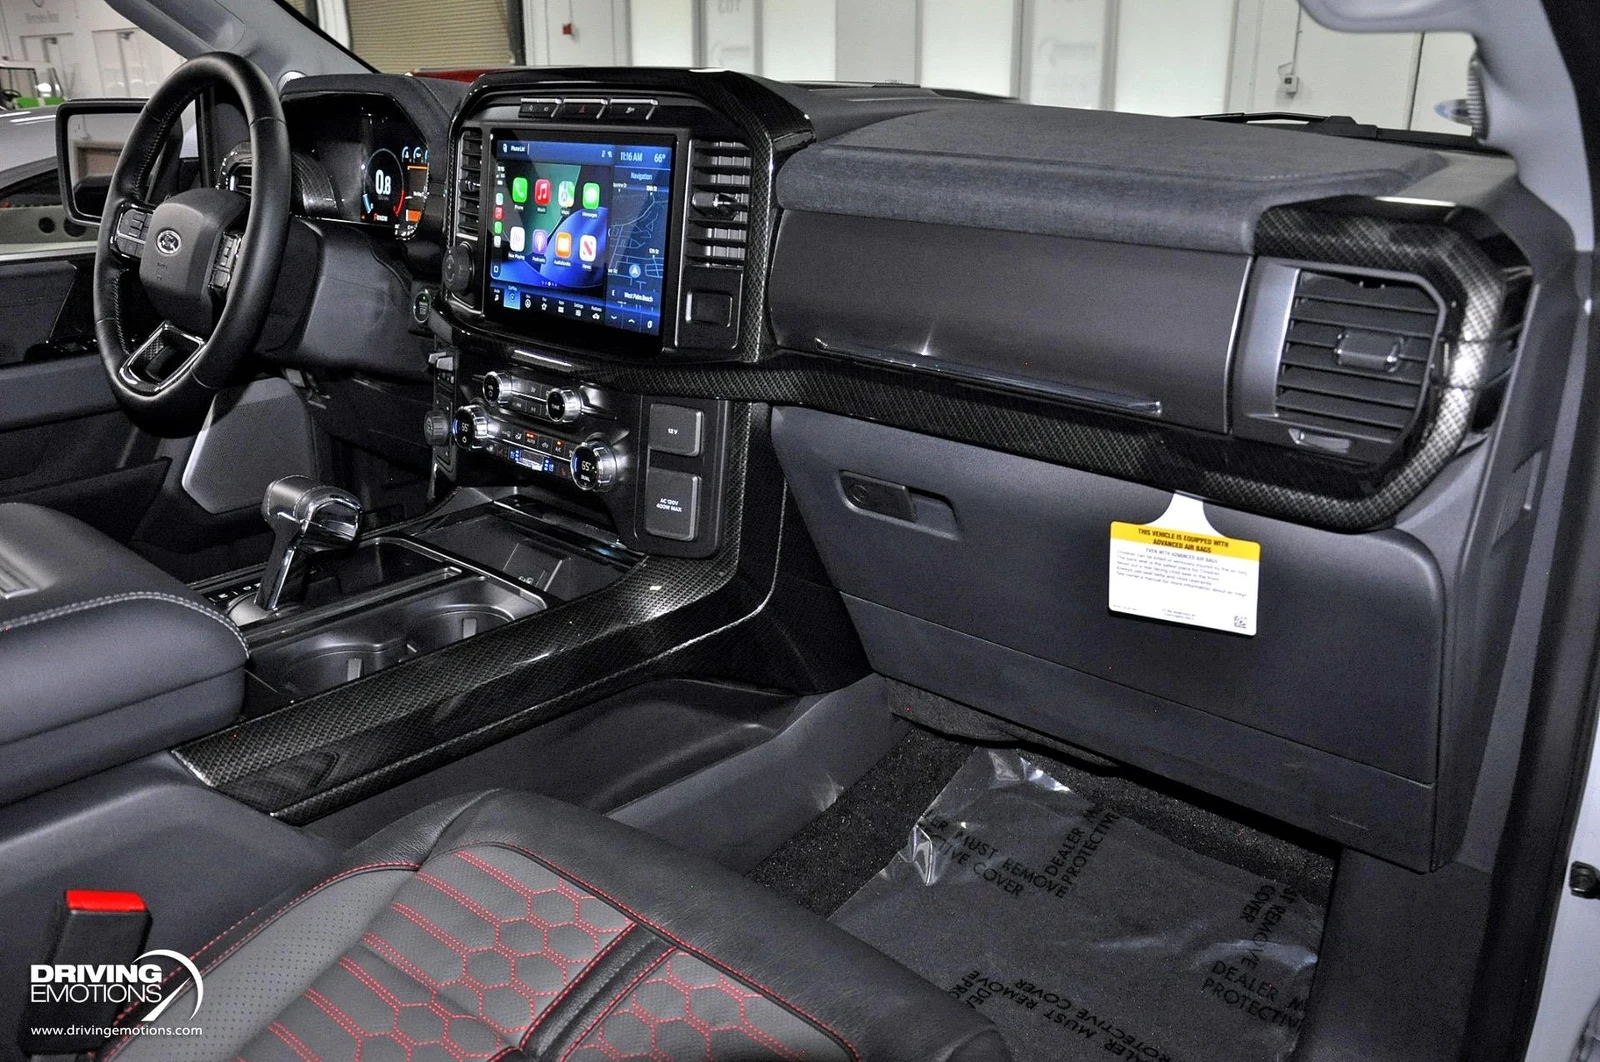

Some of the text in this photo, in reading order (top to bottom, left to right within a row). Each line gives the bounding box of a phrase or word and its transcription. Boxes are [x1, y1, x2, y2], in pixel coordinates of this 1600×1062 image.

[620, 152, 643, 162] 11:16 AM
[376, 170, 392, 195] 0.8
[630, 172, 652, 180] Navigation
[1152, 530, 1175, 540] VEHICLE
[1184, 535, 1212, 545] EQUIPPED
[1213, 540, 1229, 548] WITH
[1153, 539, 1184, 549] ADVANCED
[1196, 545, 1212, 554] BAGS
[1044, 828, 1086, 877] DEALER
[1061, 811, 1121, 886] PROTECTIVE
[972, 861, 1024, 898] COVER
[1002, 858, 1069, 899] REMOVE
[1239, 884, 1276, 923] COVER
[968, 970, 1039, 1010] REMOVE
[1014, 978, 1072, 1010] COVER
[1211, 960, 1280, 1002] DEALER
[1044, 1009, 1098, 1039] MUST
